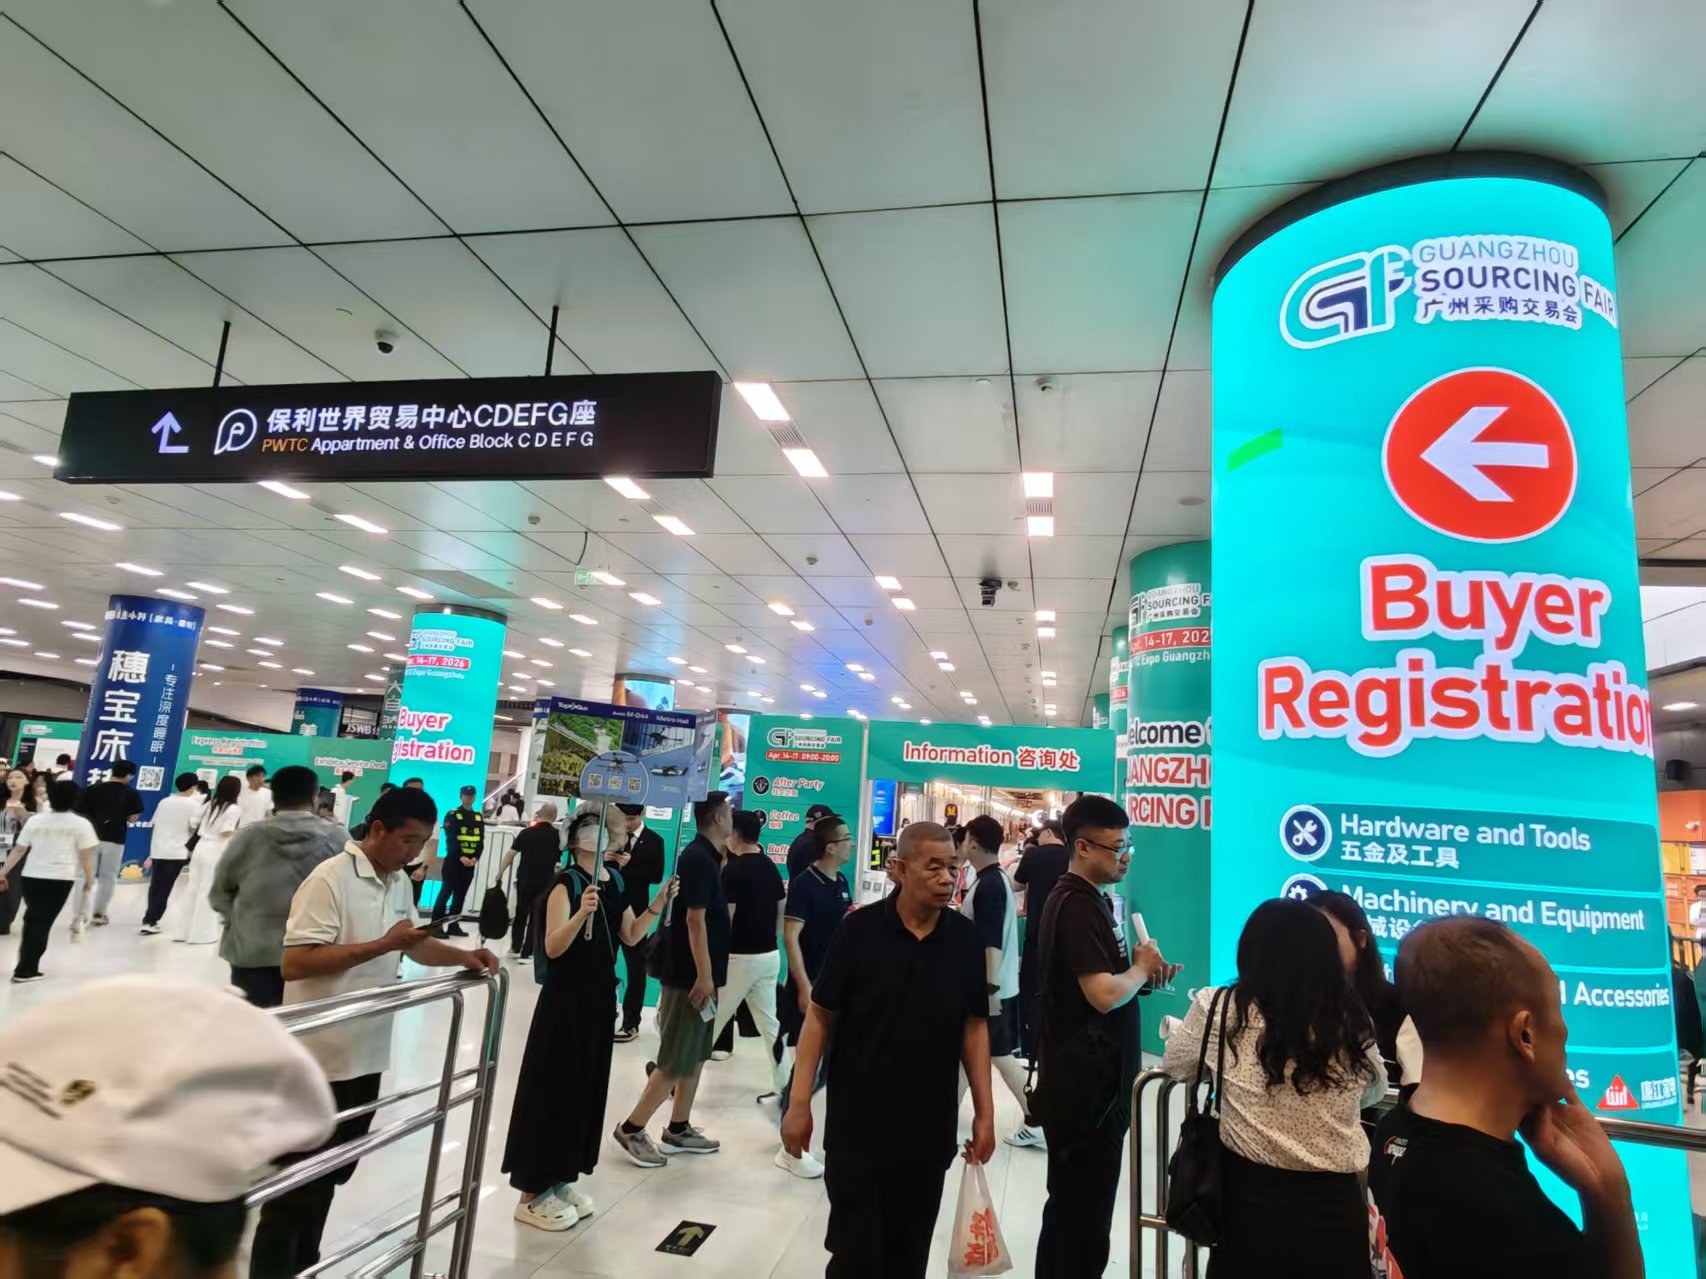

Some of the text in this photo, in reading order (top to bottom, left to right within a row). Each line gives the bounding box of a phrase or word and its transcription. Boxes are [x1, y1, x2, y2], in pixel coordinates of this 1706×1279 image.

[1419, 241, 1575, 268] GUANGZHOU
[1421, 265, 1577, 298] SOURCING
[1421, 296, 1578, 325] 广州采购交易会
[266, 399, 597, 433] 保利世界贸易中心CDEFG座
[261, 438, 309, 453] PWTC
[311, 437, 400, 455] Appartment
[403, 435, 416, 450] &
[418, 434, 466, 450] Office
[469, 433, 514, 449] Block
[1147, 594, 1199, 611] SOURCING
[1369, 562, 1606, 651] Buyer
[1144, 631, 1177, 647] 14-17,
[1182, 629, 1210, 643] 202
[442, 657, 465, 668] 2026
[1162, 649, 1211, 664] Guangzh
[1129, 719, 1202, 745] elcome
[904, 742, 1079, 770] Information 咨询处
[798, 778, 825, 790] Party
[1130, 756, 1211, 785] ANGZH
[1129, 796, 1196, 826] RCING
[1340, 813, 1591, 851] Hardware and Tools
[1340, 841, 1460, 870] 五金及工具
[1341, 885, 1645, 935] Machinery and Equipment
[1573, 980, 1670, 1008] Accessories
